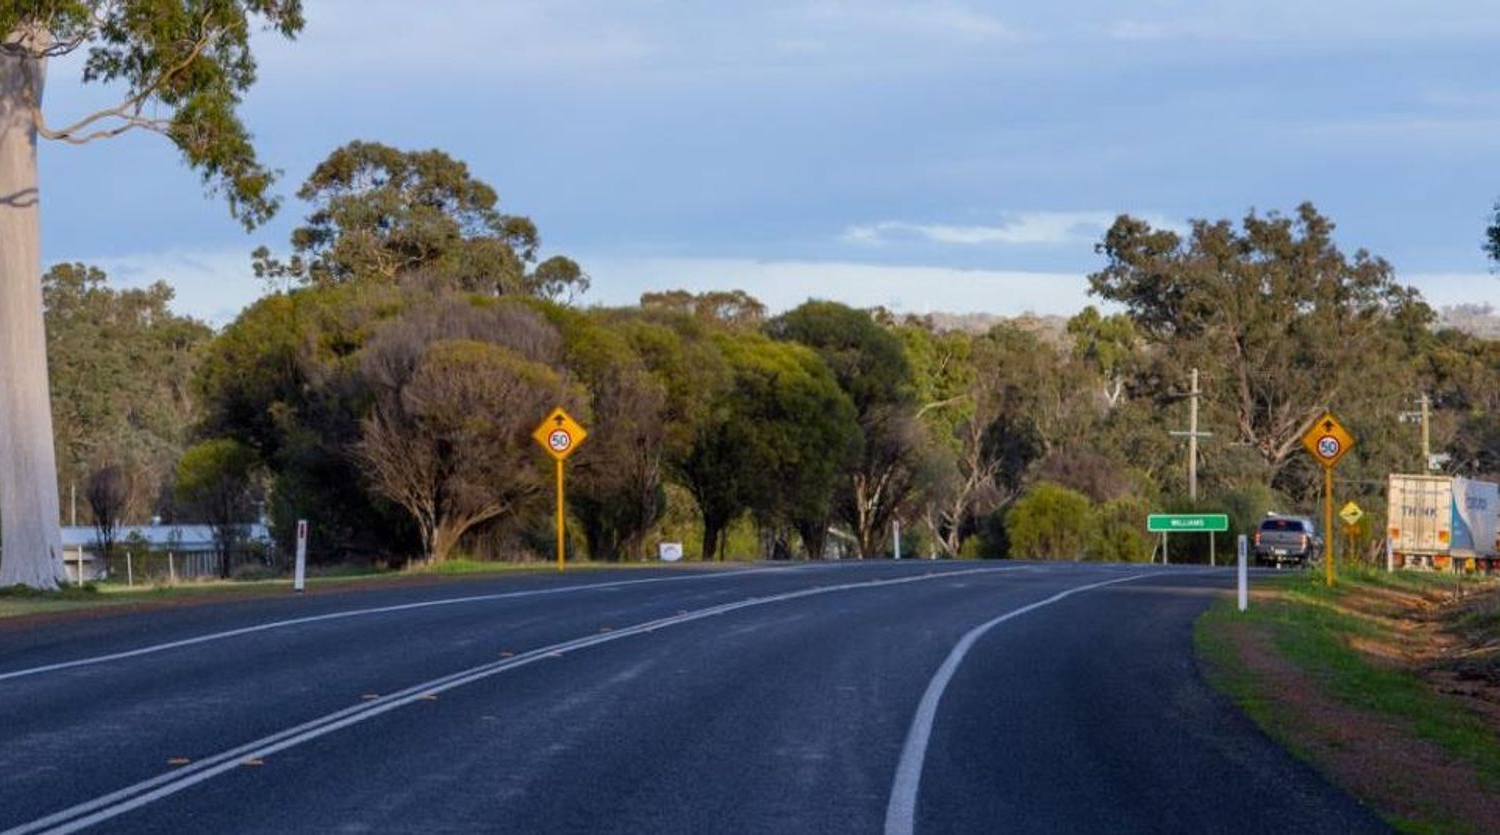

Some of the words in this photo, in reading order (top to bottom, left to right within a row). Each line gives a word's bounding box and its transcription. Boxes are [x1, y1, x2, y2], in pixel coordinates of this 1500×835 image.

[552, 434, 568, 447] 50
[1321, 440, 1337, 454] 50
[1170, 518, 1205, 527] WILLIAMS
